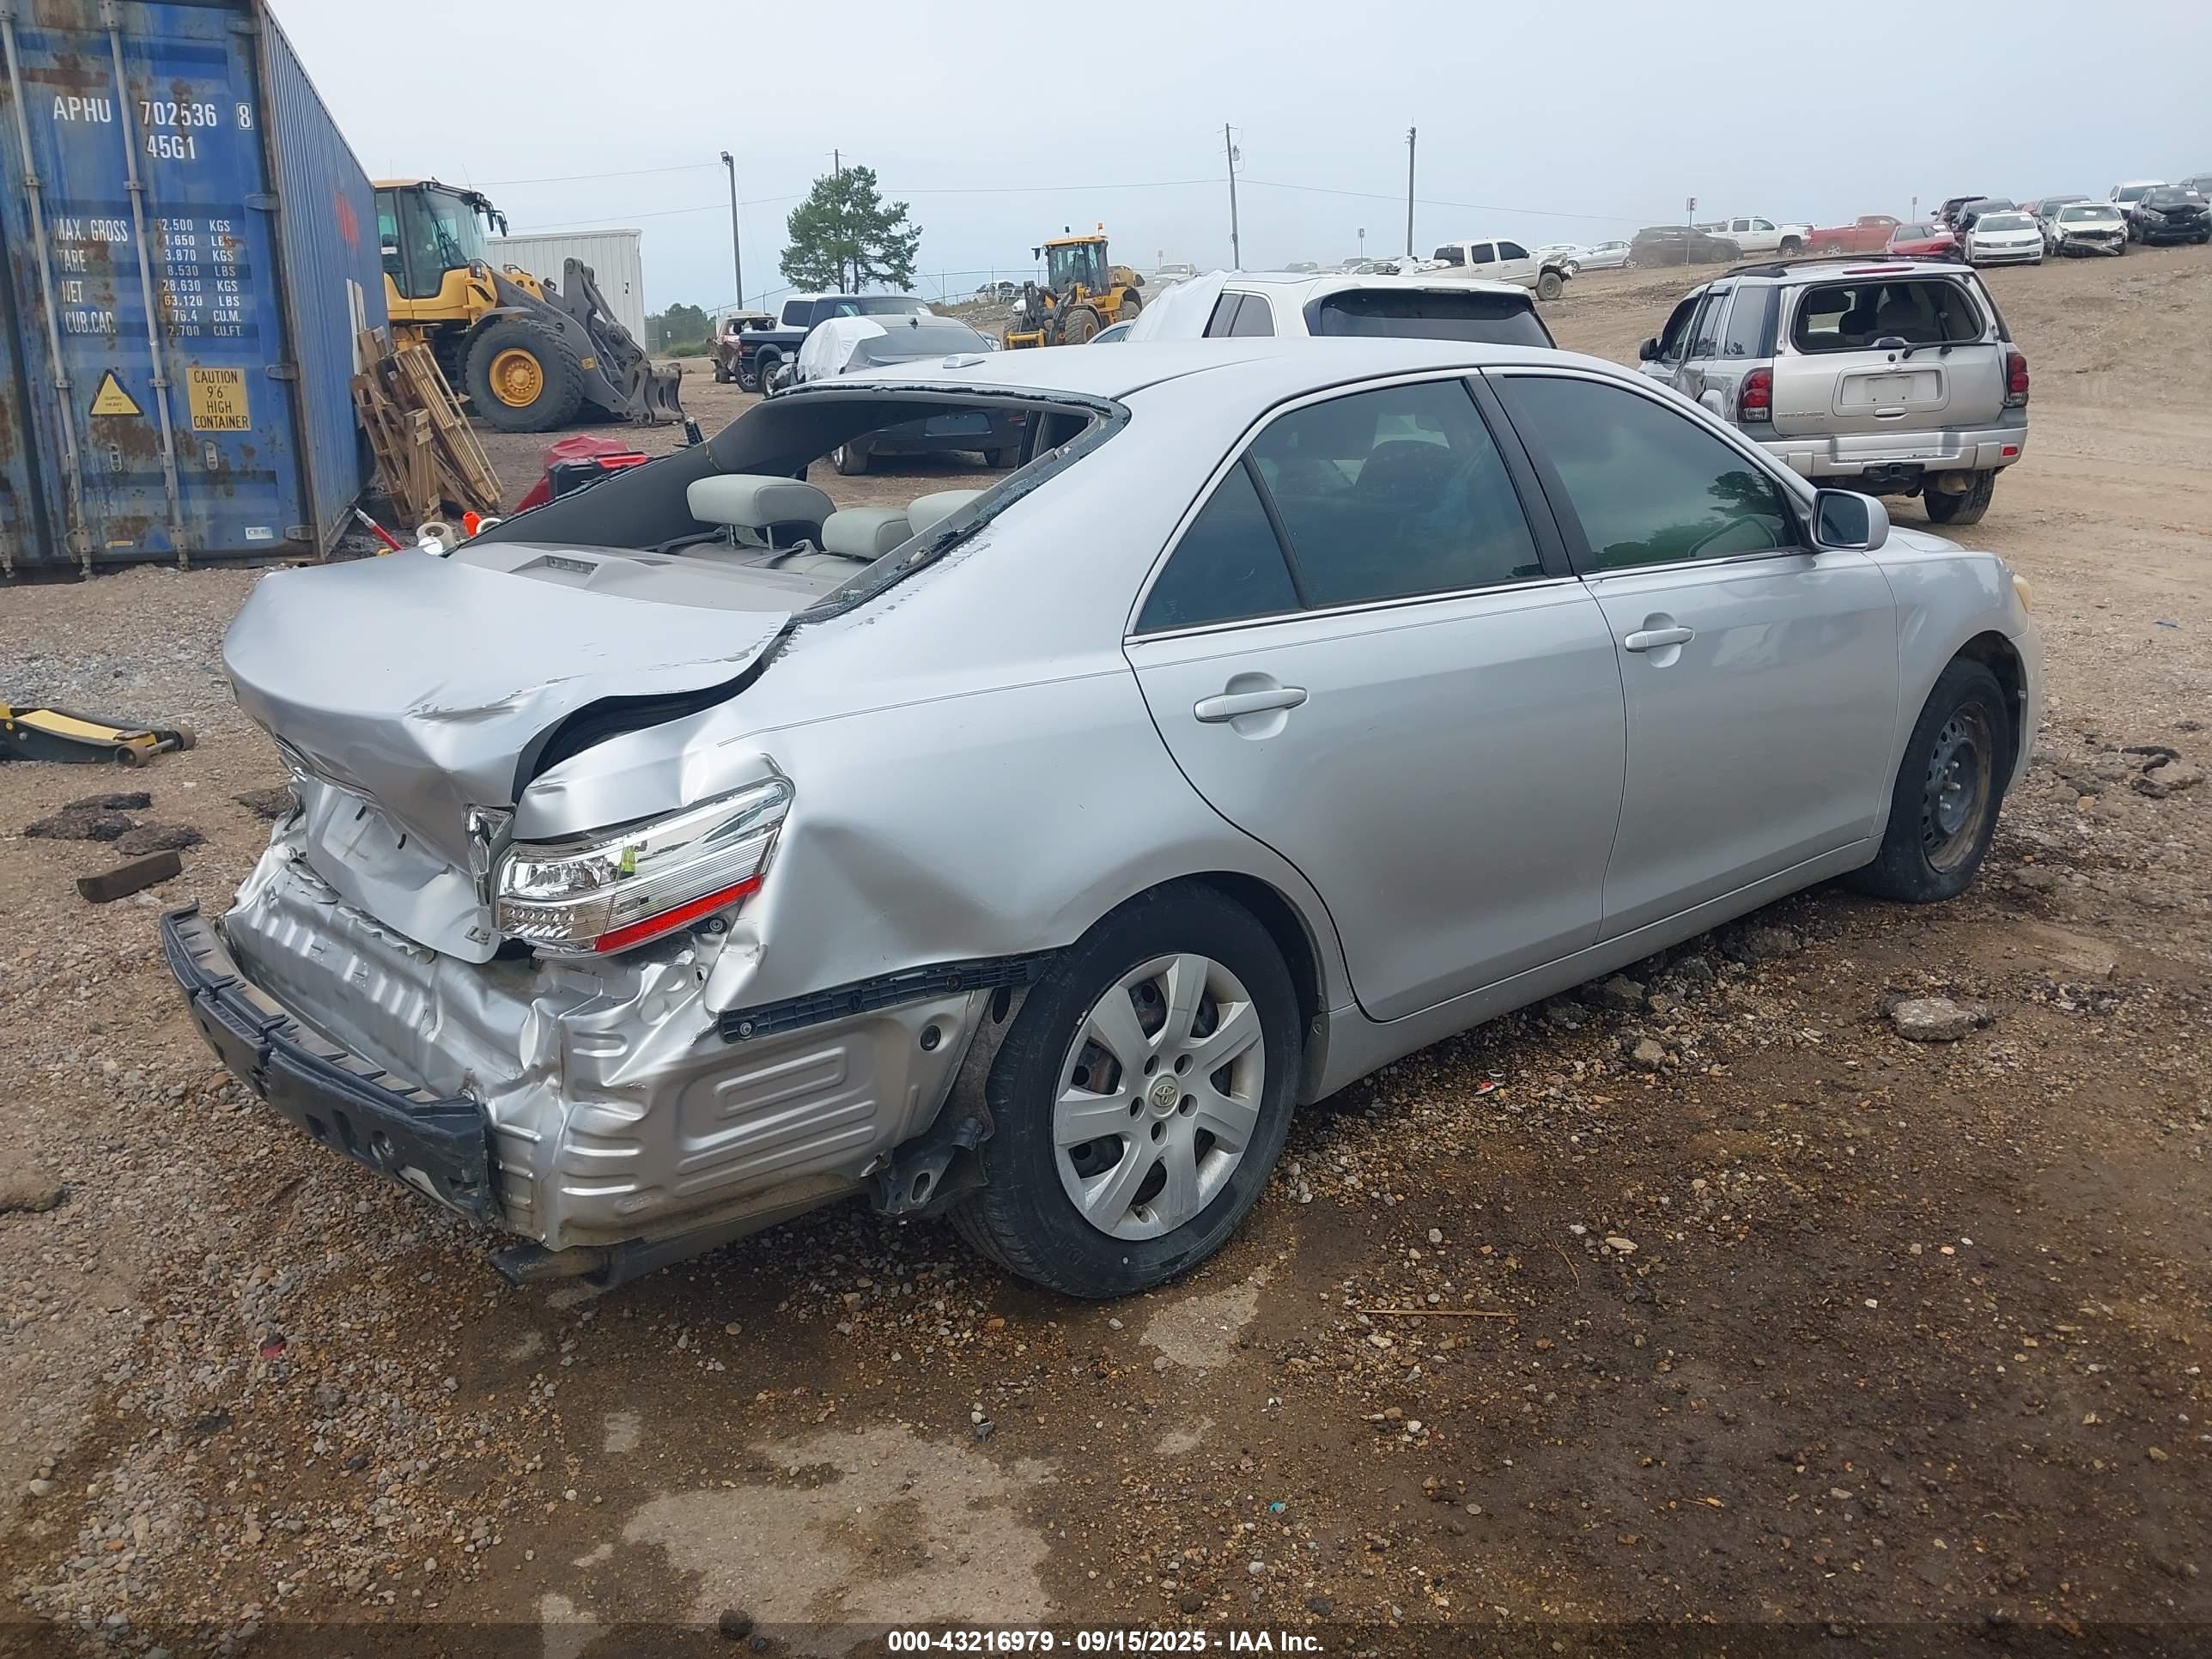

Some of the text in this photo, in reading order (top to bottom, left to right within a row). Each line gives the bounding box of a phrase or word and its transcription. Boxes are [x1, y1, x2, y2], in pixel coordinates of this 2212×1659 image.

[53, 95, 252, 128] APHU 702536 8
[147, 135, 196, 159] 45G1
[1689, 198, 1695, 211] E
[53, 218, 230, 241] MAX. GROSS 2.500 KGS
[210, 235, 233, 247] LBS
[56, 249, 234, 272] TARE 3.870 KGS
[167, 264, 236, 277] 8.530 LBS
[61, 279, 238, 303] NET 28.630 KGS
[163, 295, 240, 307] 63.120 LBS
[172, 309, 198, 322] 76.4
[212, 310, 242, 323] CU.M.
[167, 325, 200, 337] 2.700
[193, 370, 239, 384] CAUTION
[206, 400, 233, 415] HIGH
[193, 415, 249, 429] CONTAINER
